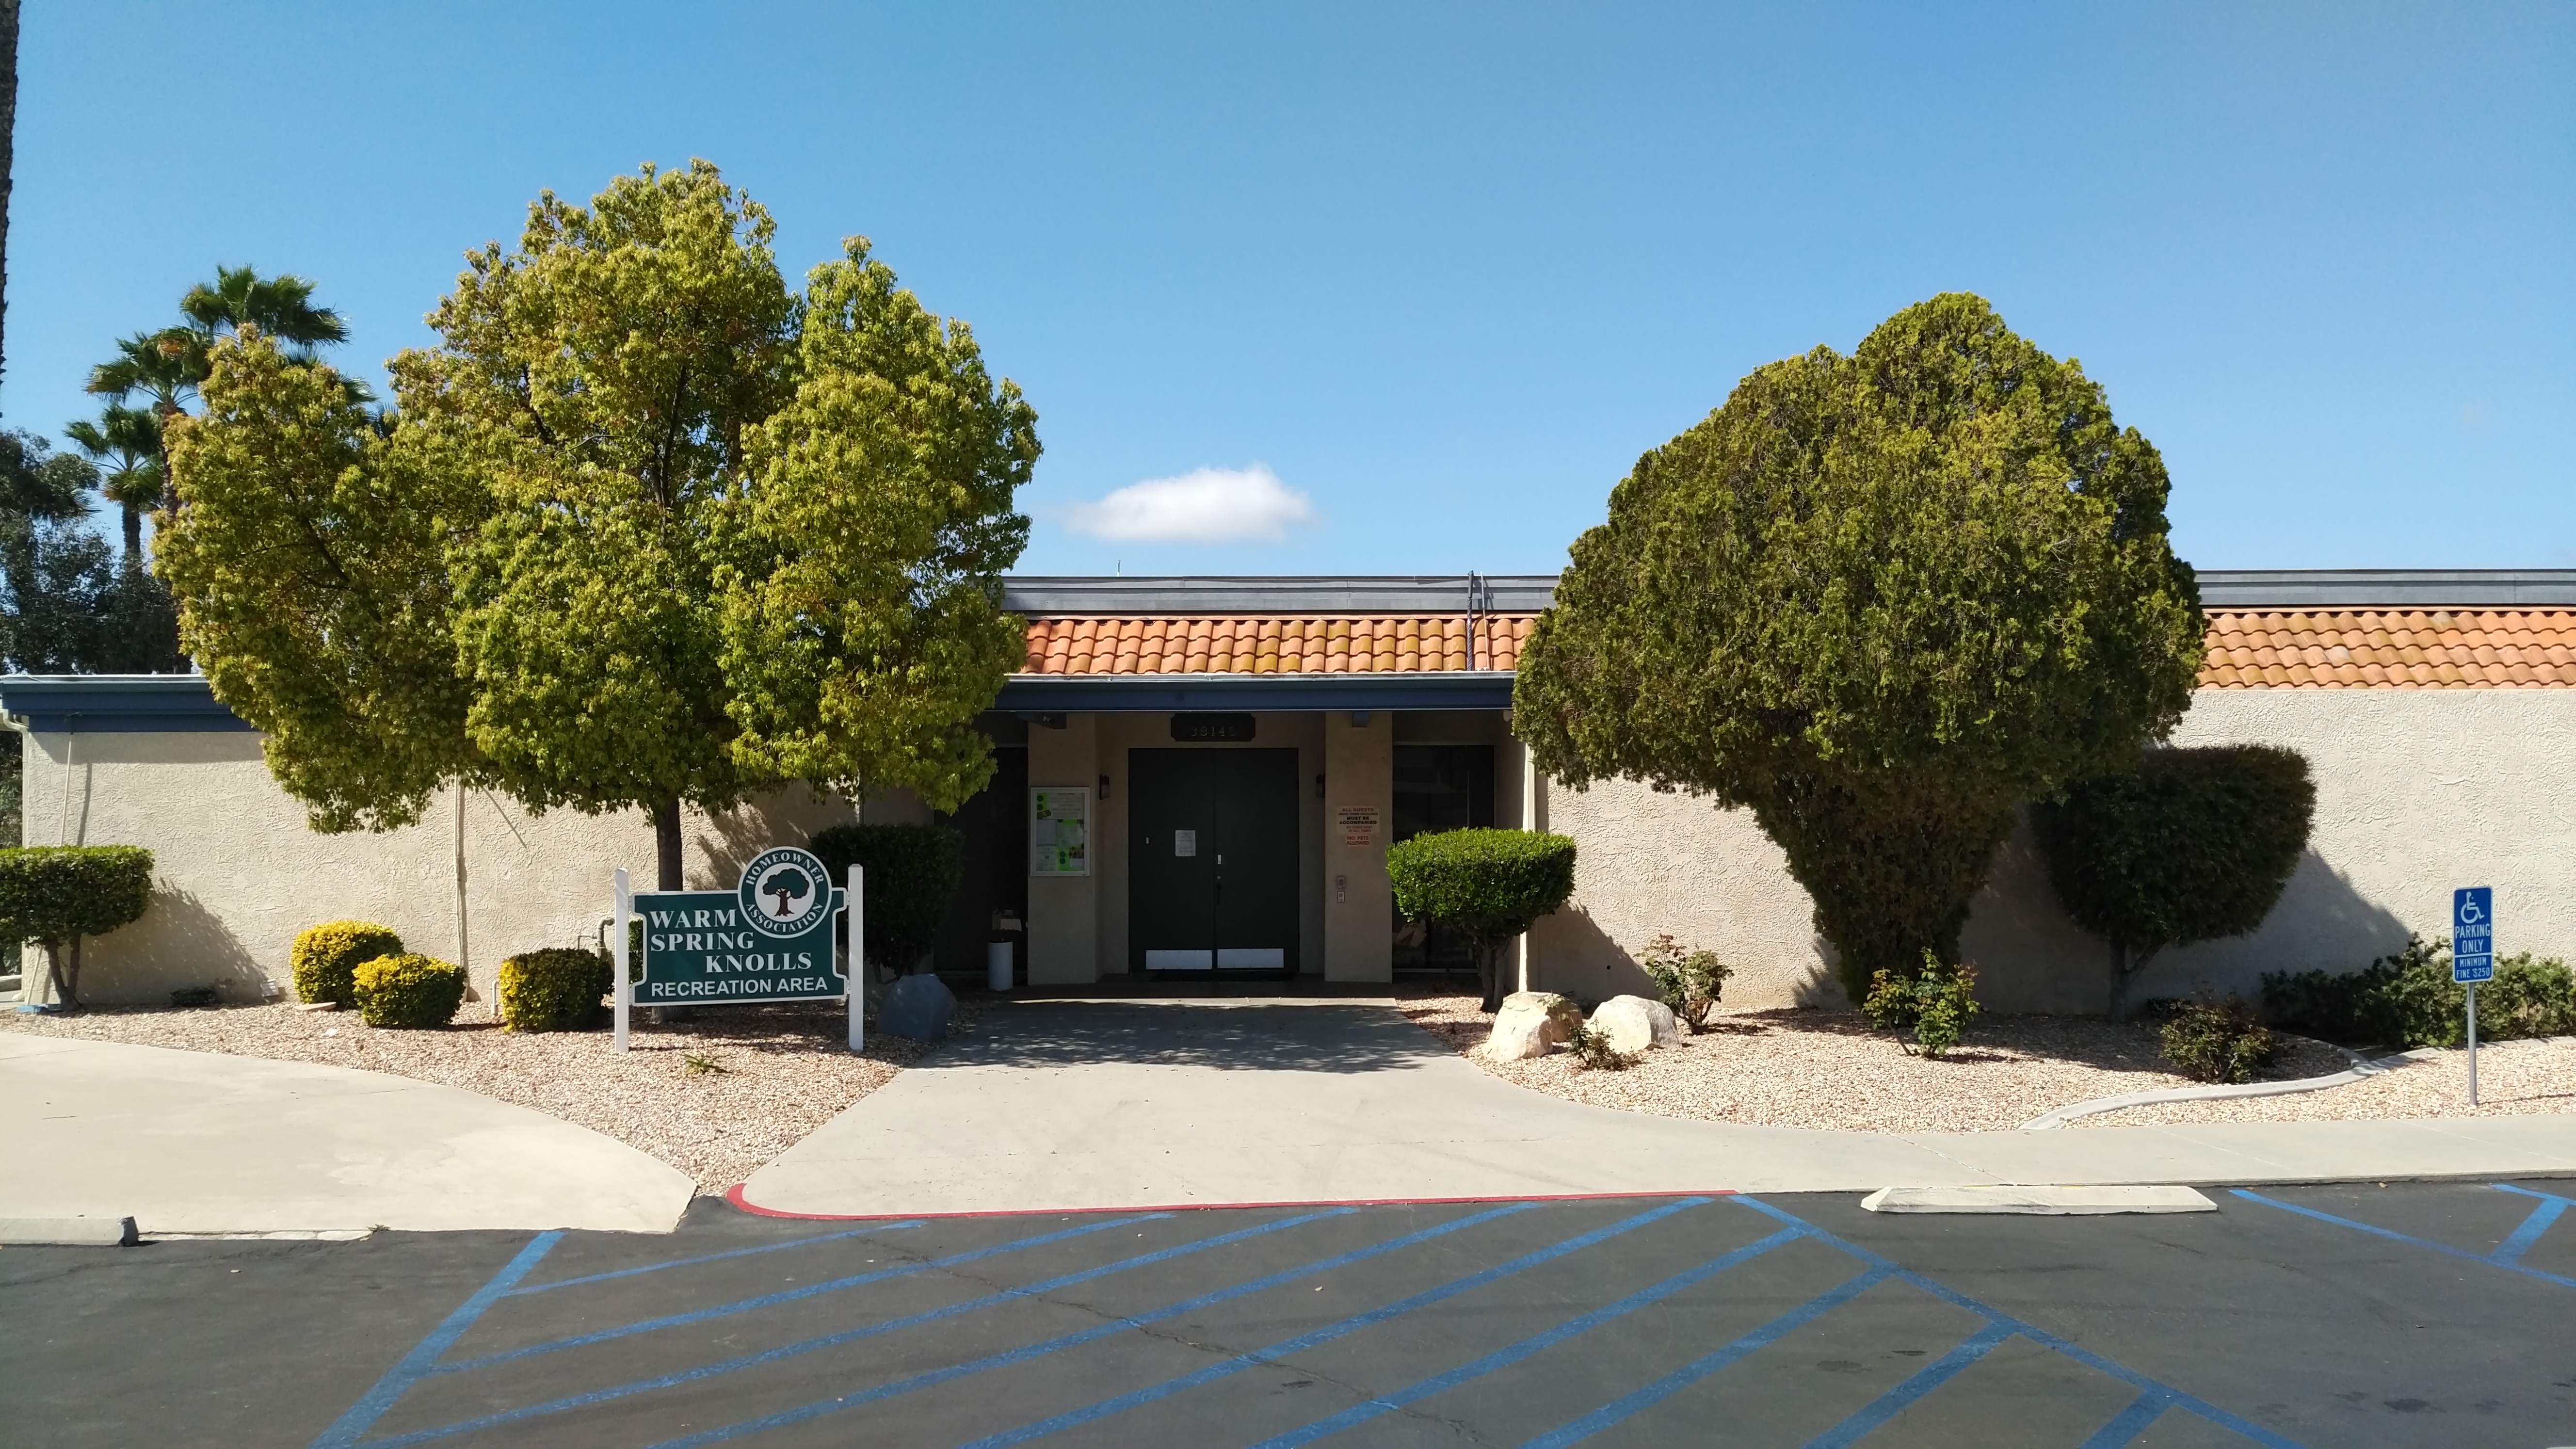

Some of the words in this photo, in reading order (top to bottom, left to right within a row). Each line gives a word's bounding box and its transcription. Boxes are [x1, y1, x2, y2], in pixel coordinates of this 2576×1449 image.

[746, 852, 824, 886] HOMEOWNER
[648, 909, 737, 929] WARM
[746, 902, 823, 933] ASSOCIATION
[2455, 923, 2490, 939] PARKING
[650, 932, 754, 952] SPRING
[2462, 939, 2484, 953] ONLY
[705, 952, 812, 973] KNOLLS
[2460, 956, 2487, 967] MINIMUM
[2456, 969, 2470, 979] FINE
[2472, 967, 2490, 978] $250
[651, 979, 772, 997] RECREATION
[776, 977, 828, 993] AREA
